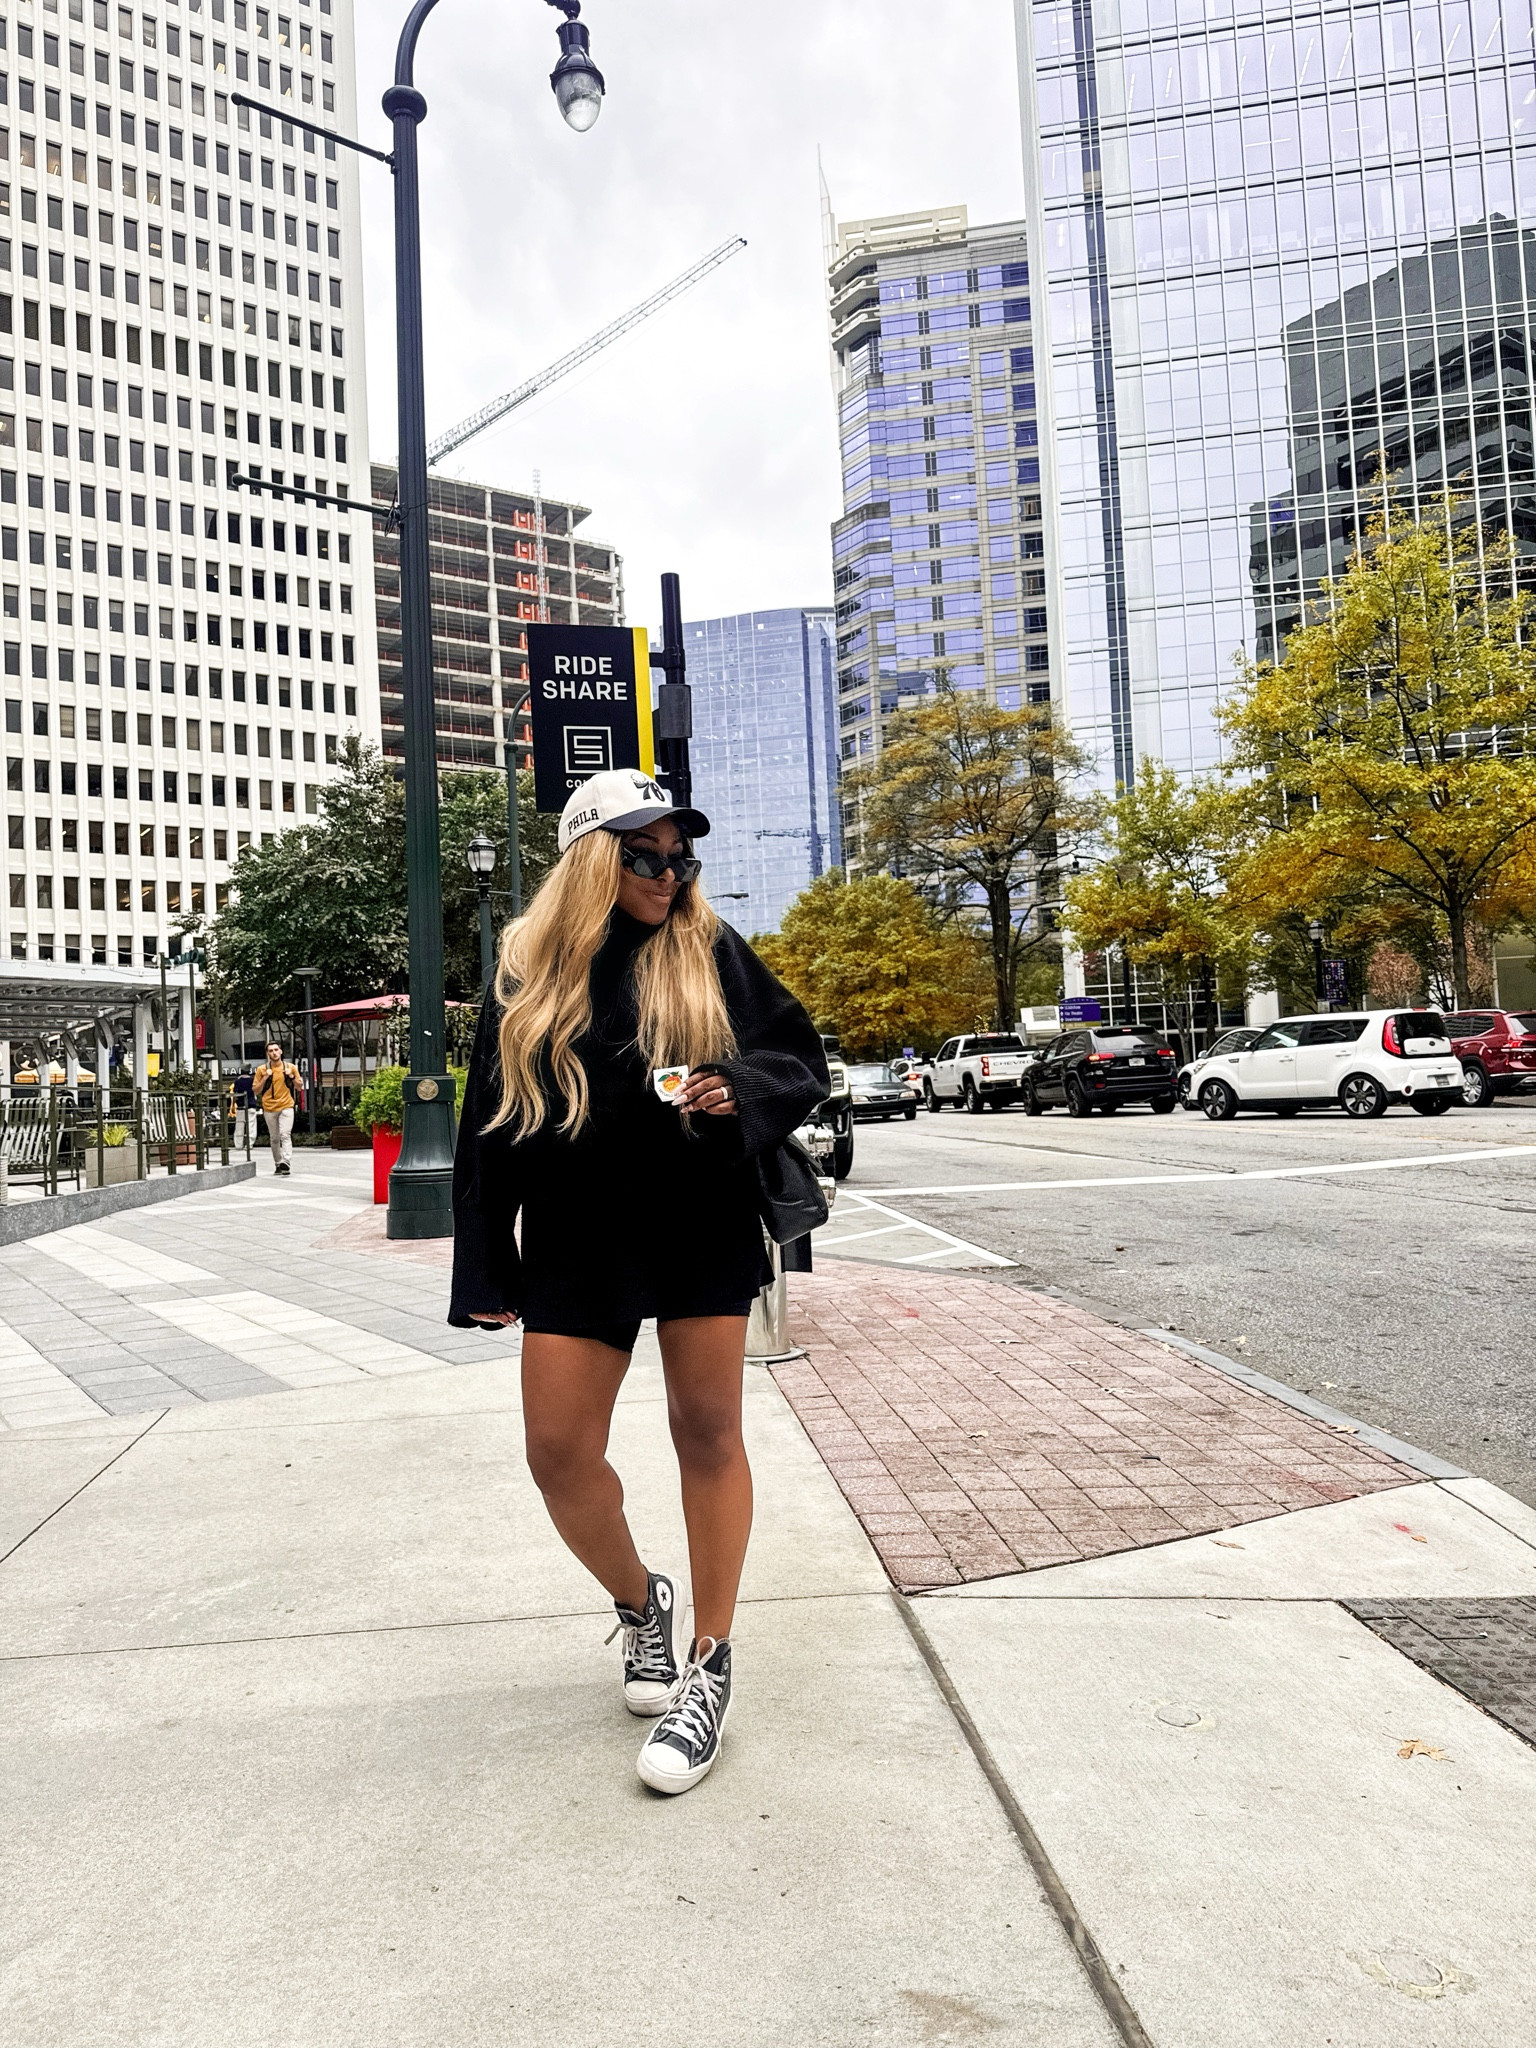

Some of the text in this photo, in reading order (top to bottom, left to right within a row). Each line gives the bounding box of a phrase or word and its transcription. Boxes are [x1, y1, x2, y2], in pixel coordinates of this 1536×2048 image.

[554, 655, 613, 676] RIDE
[542, 679, 628, 701] SHARE
[567, 808, 600, 836] PHILA
